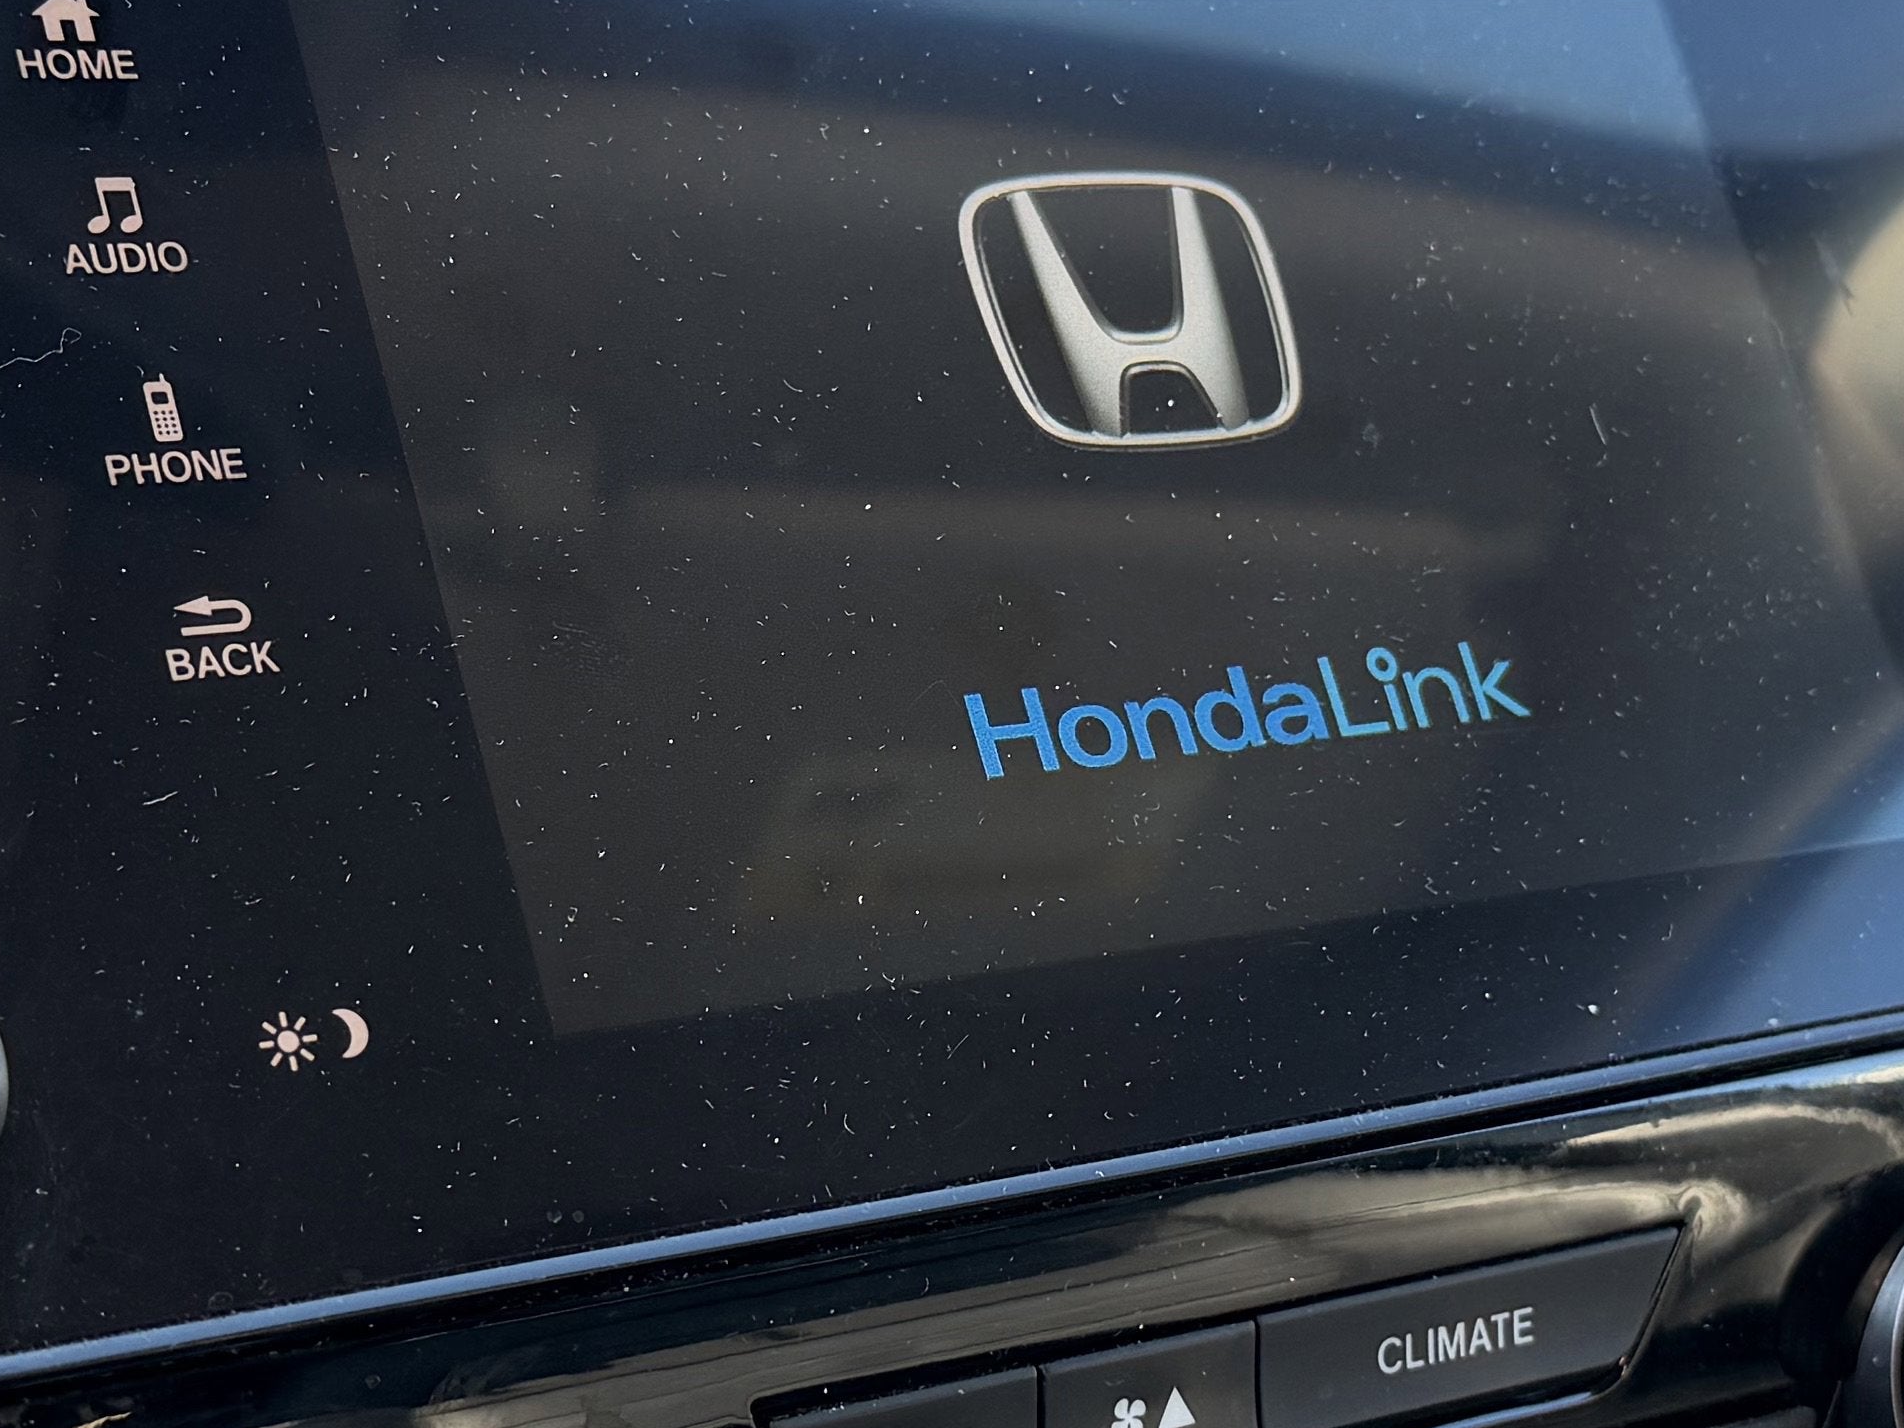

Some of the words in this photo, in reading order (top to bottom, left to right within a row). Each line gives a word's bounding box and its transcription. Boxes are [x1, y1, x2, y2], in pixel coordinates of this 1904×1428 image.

[16, 49, 139, 81] HOME
[65, 241, 188, 275] AUDIO
[105, 448, 247, 486] PHONE
[166, 642, 281, 682] BACK
[963, 641, 1531, 780] HondaLink
[1377, 1307, 1534, 1374] CLIMATE
